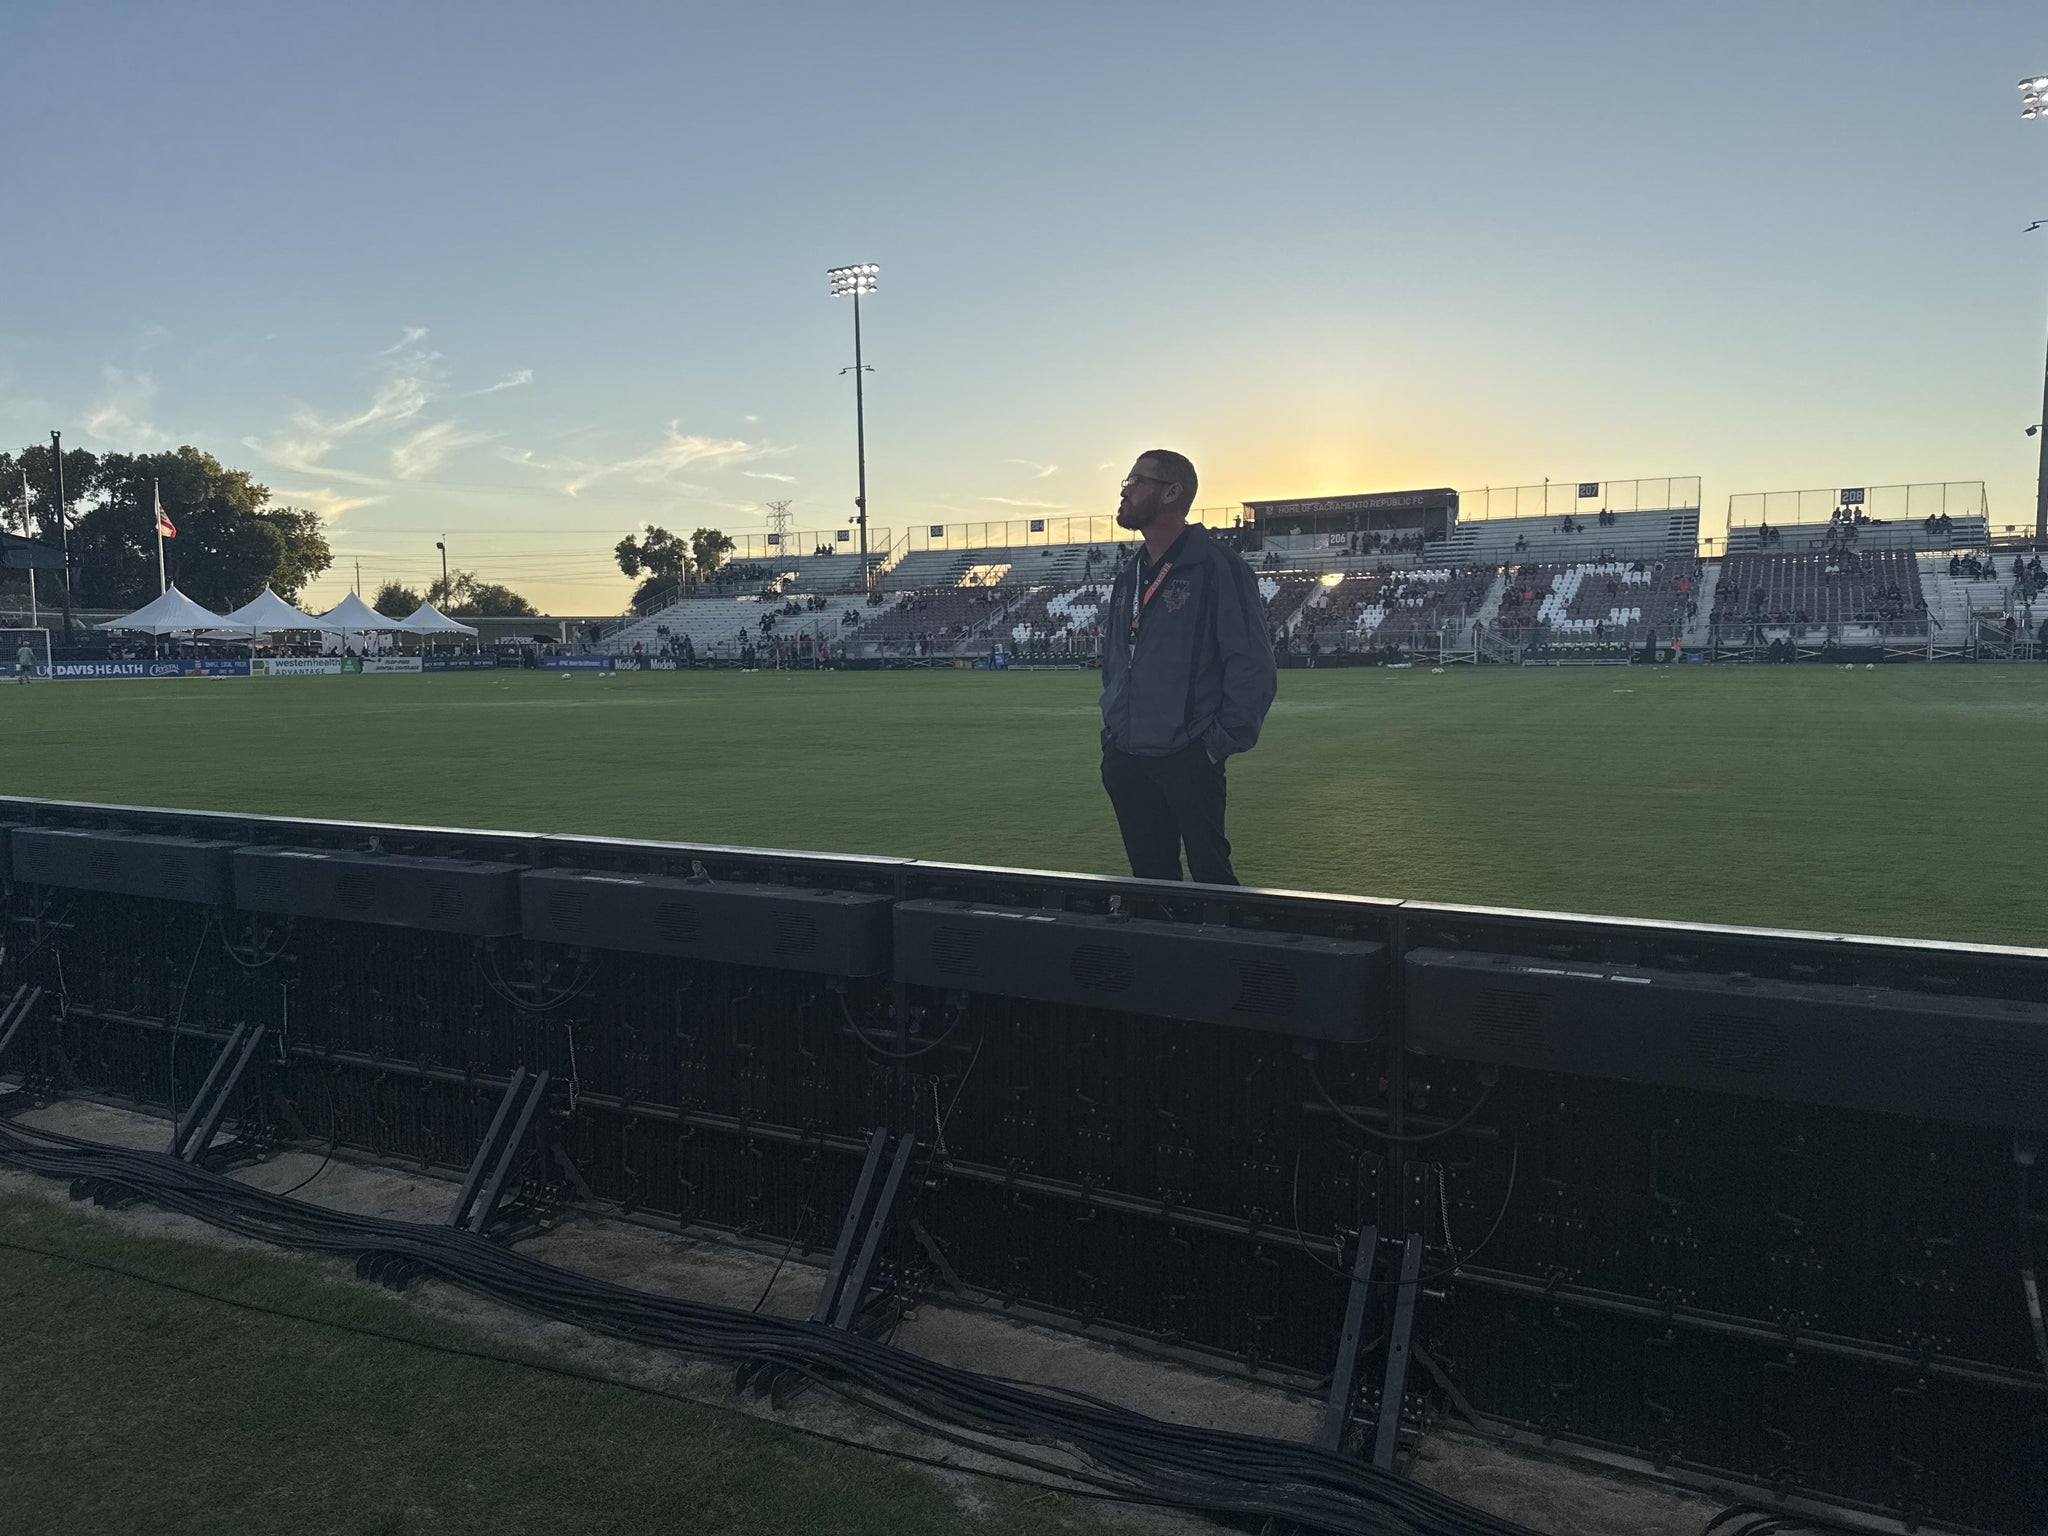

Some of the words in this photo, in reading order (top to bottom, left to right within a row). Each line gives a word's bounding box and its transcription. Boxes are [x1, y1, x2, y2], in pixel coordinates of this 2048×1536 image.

[1580, 485, 1597, 496] 207
[1842, 490, 1863, 502] 208
[1278, 505, 1300, 513] HOME
[1301, 505, 1312, 513] OF
[1313, 501, 1369, 512] SACRAMENTO
[1370, 497, 1411, 508] REPUBLIC
[1412, 496, 1424, 505] FC
[1330, 533, 1346, 544] 206
[95, 664, 143, 675] HEALTH
[650, 659, 677, 670] Modelo
